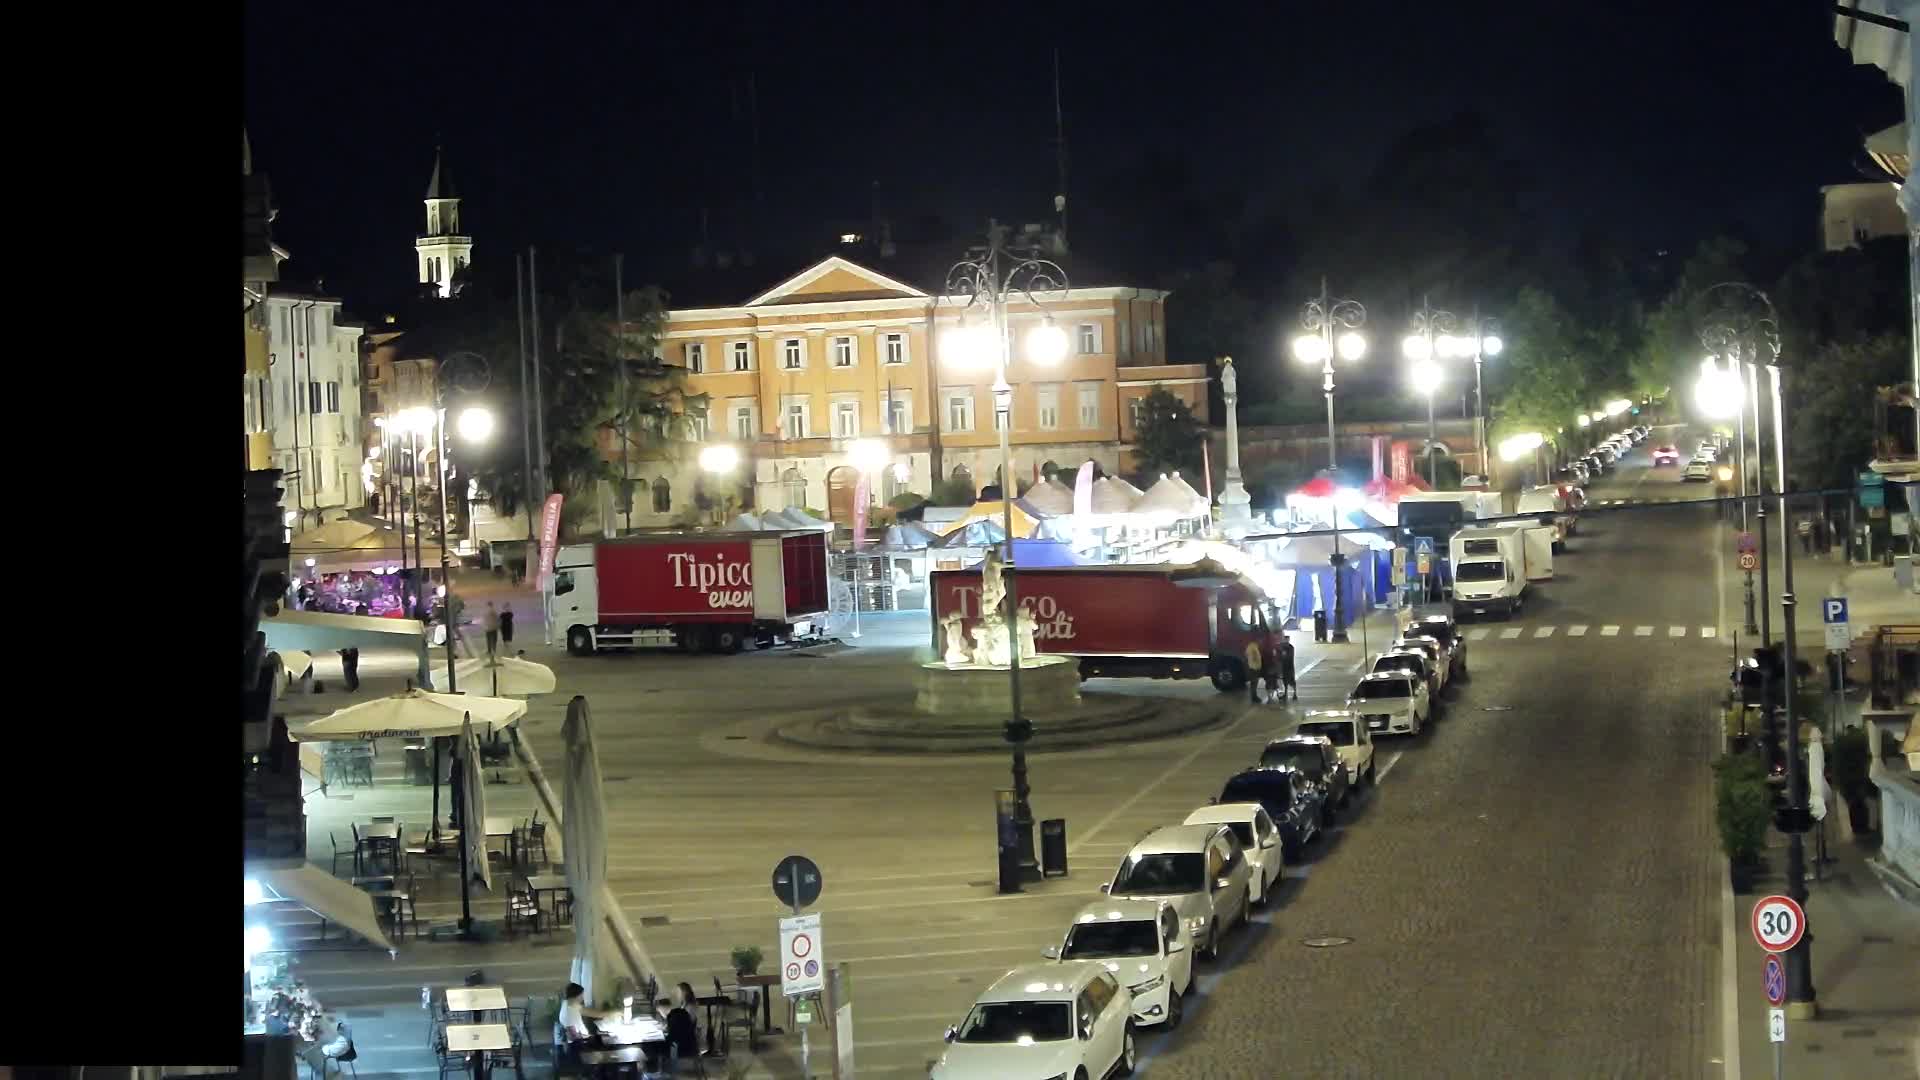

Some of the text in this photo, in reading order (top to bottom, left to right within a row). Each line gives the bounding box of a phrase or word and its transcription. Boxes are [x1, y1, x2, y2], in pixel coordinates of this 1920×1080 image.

[1743, 556, 1753, 567] 20
[1827, 601, 1843, 621] P
[1762, 911, 1792, 937] 30
